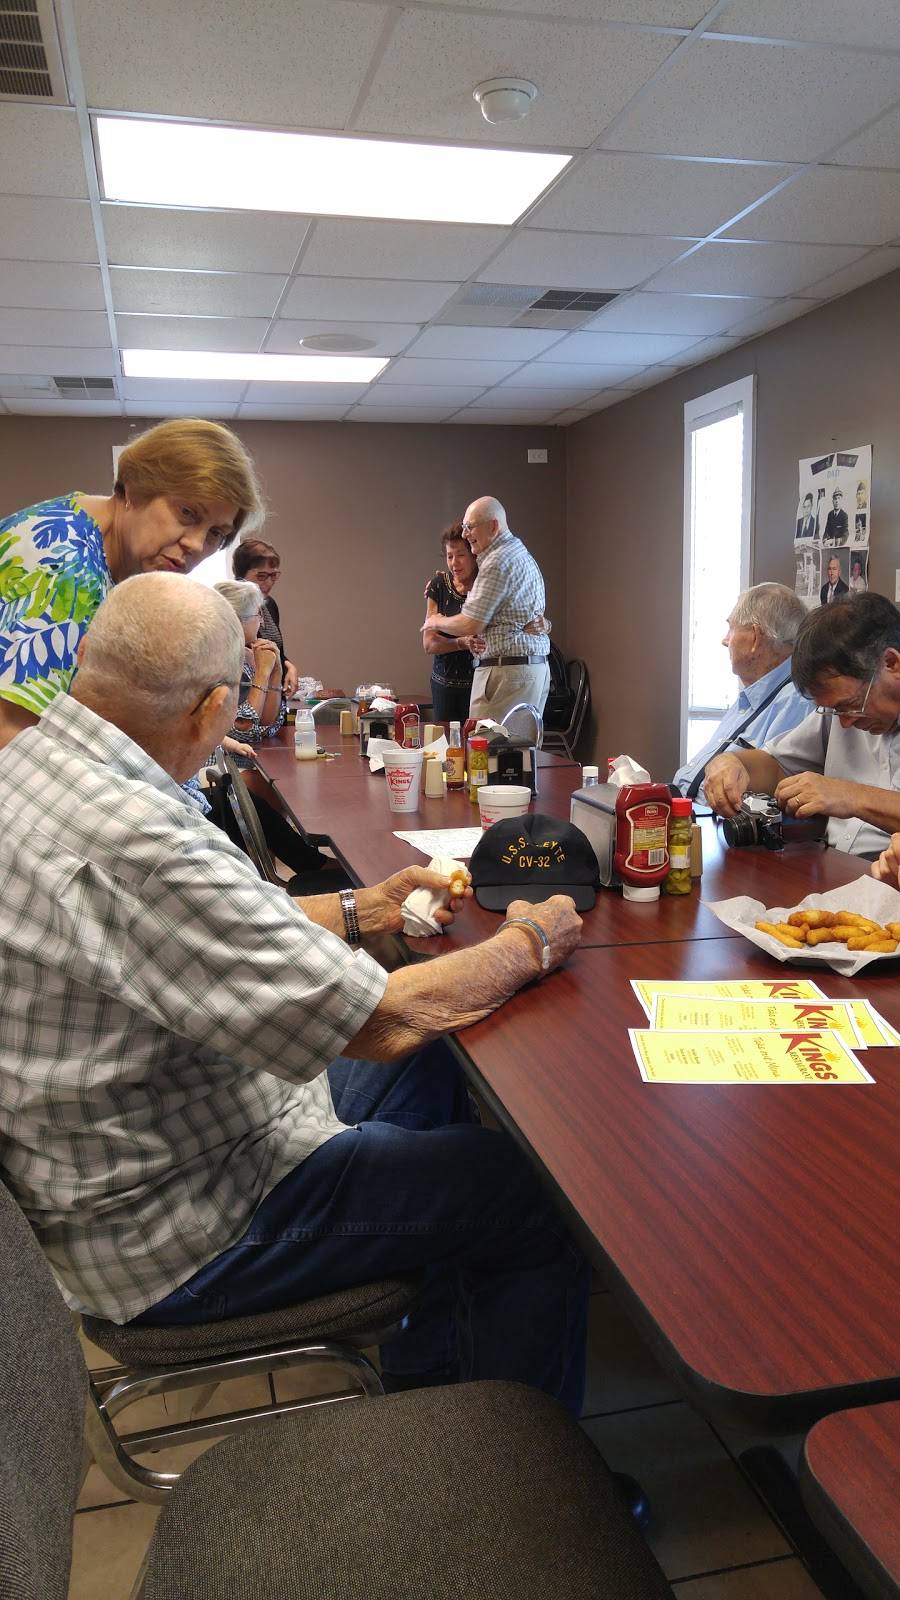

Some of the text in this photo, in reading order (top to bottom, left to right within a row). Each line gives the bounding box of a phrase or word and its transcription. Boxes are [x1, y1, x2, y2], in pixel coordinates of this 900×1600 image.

[501, 837, 529, 864] U.S.S.
[536, 841, 566, 863] EYTE
[519, 855, 551, 868] CV-32
[779, 1033, 838, 1080] KINGS
